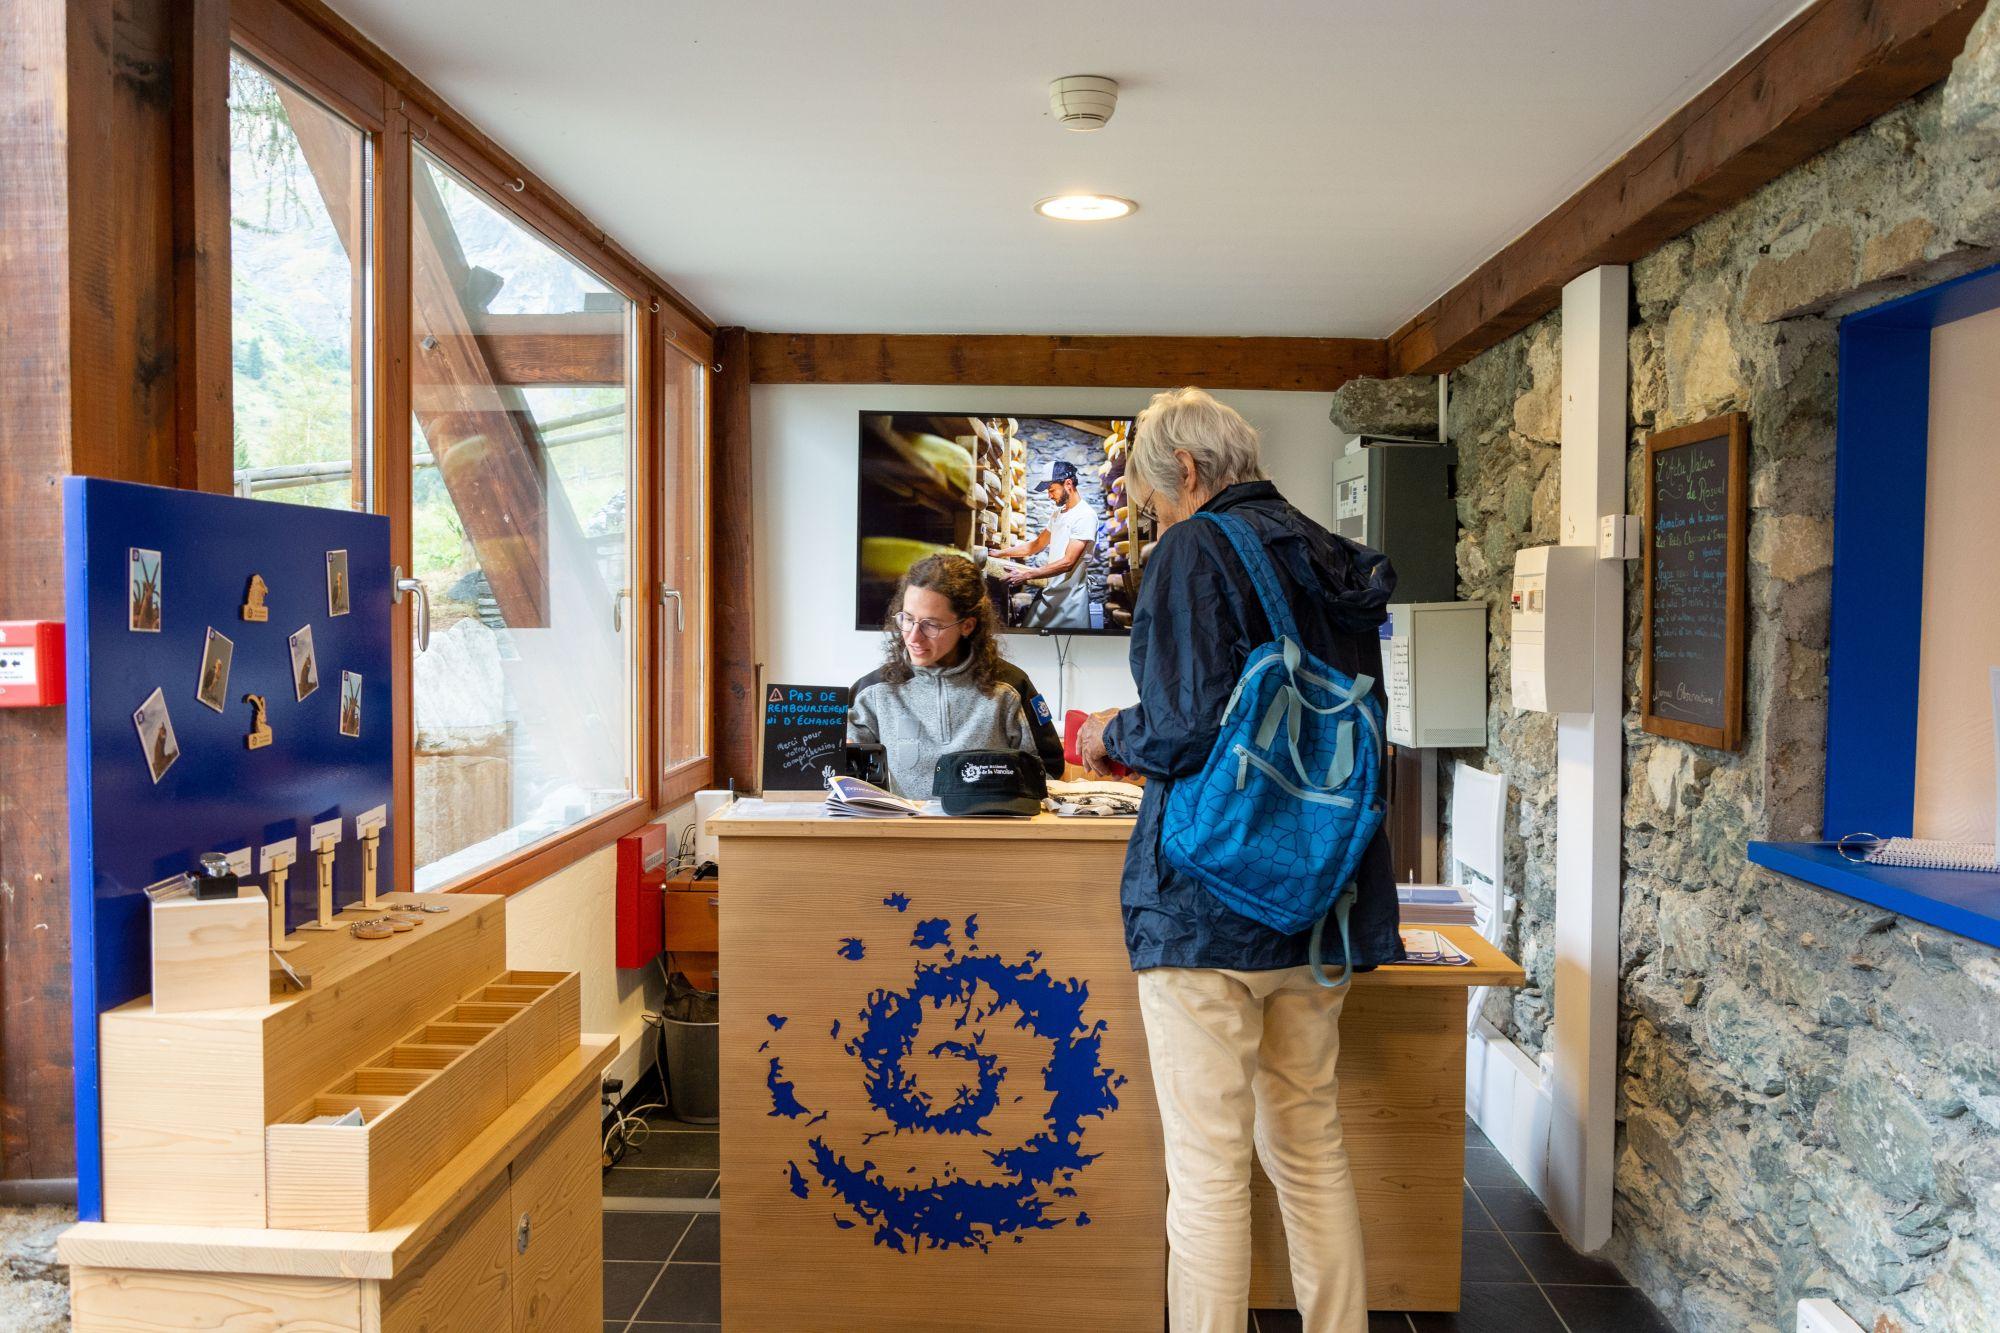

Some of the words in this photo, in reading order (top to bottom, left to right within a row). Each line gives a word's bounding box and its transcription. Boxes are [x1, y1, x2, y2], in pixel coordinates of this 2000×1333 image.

[1686, 480, 1697, 500] de
[788, 689, 813, 702] PAS
[819, 691, 837, 702] DE
[767, 703, 849, 715] REMBOURSEMENT
[777, 737, 798, 751] Merci
[802, 731, 822, 746] pour
[785, 745, 806, 758] votre
